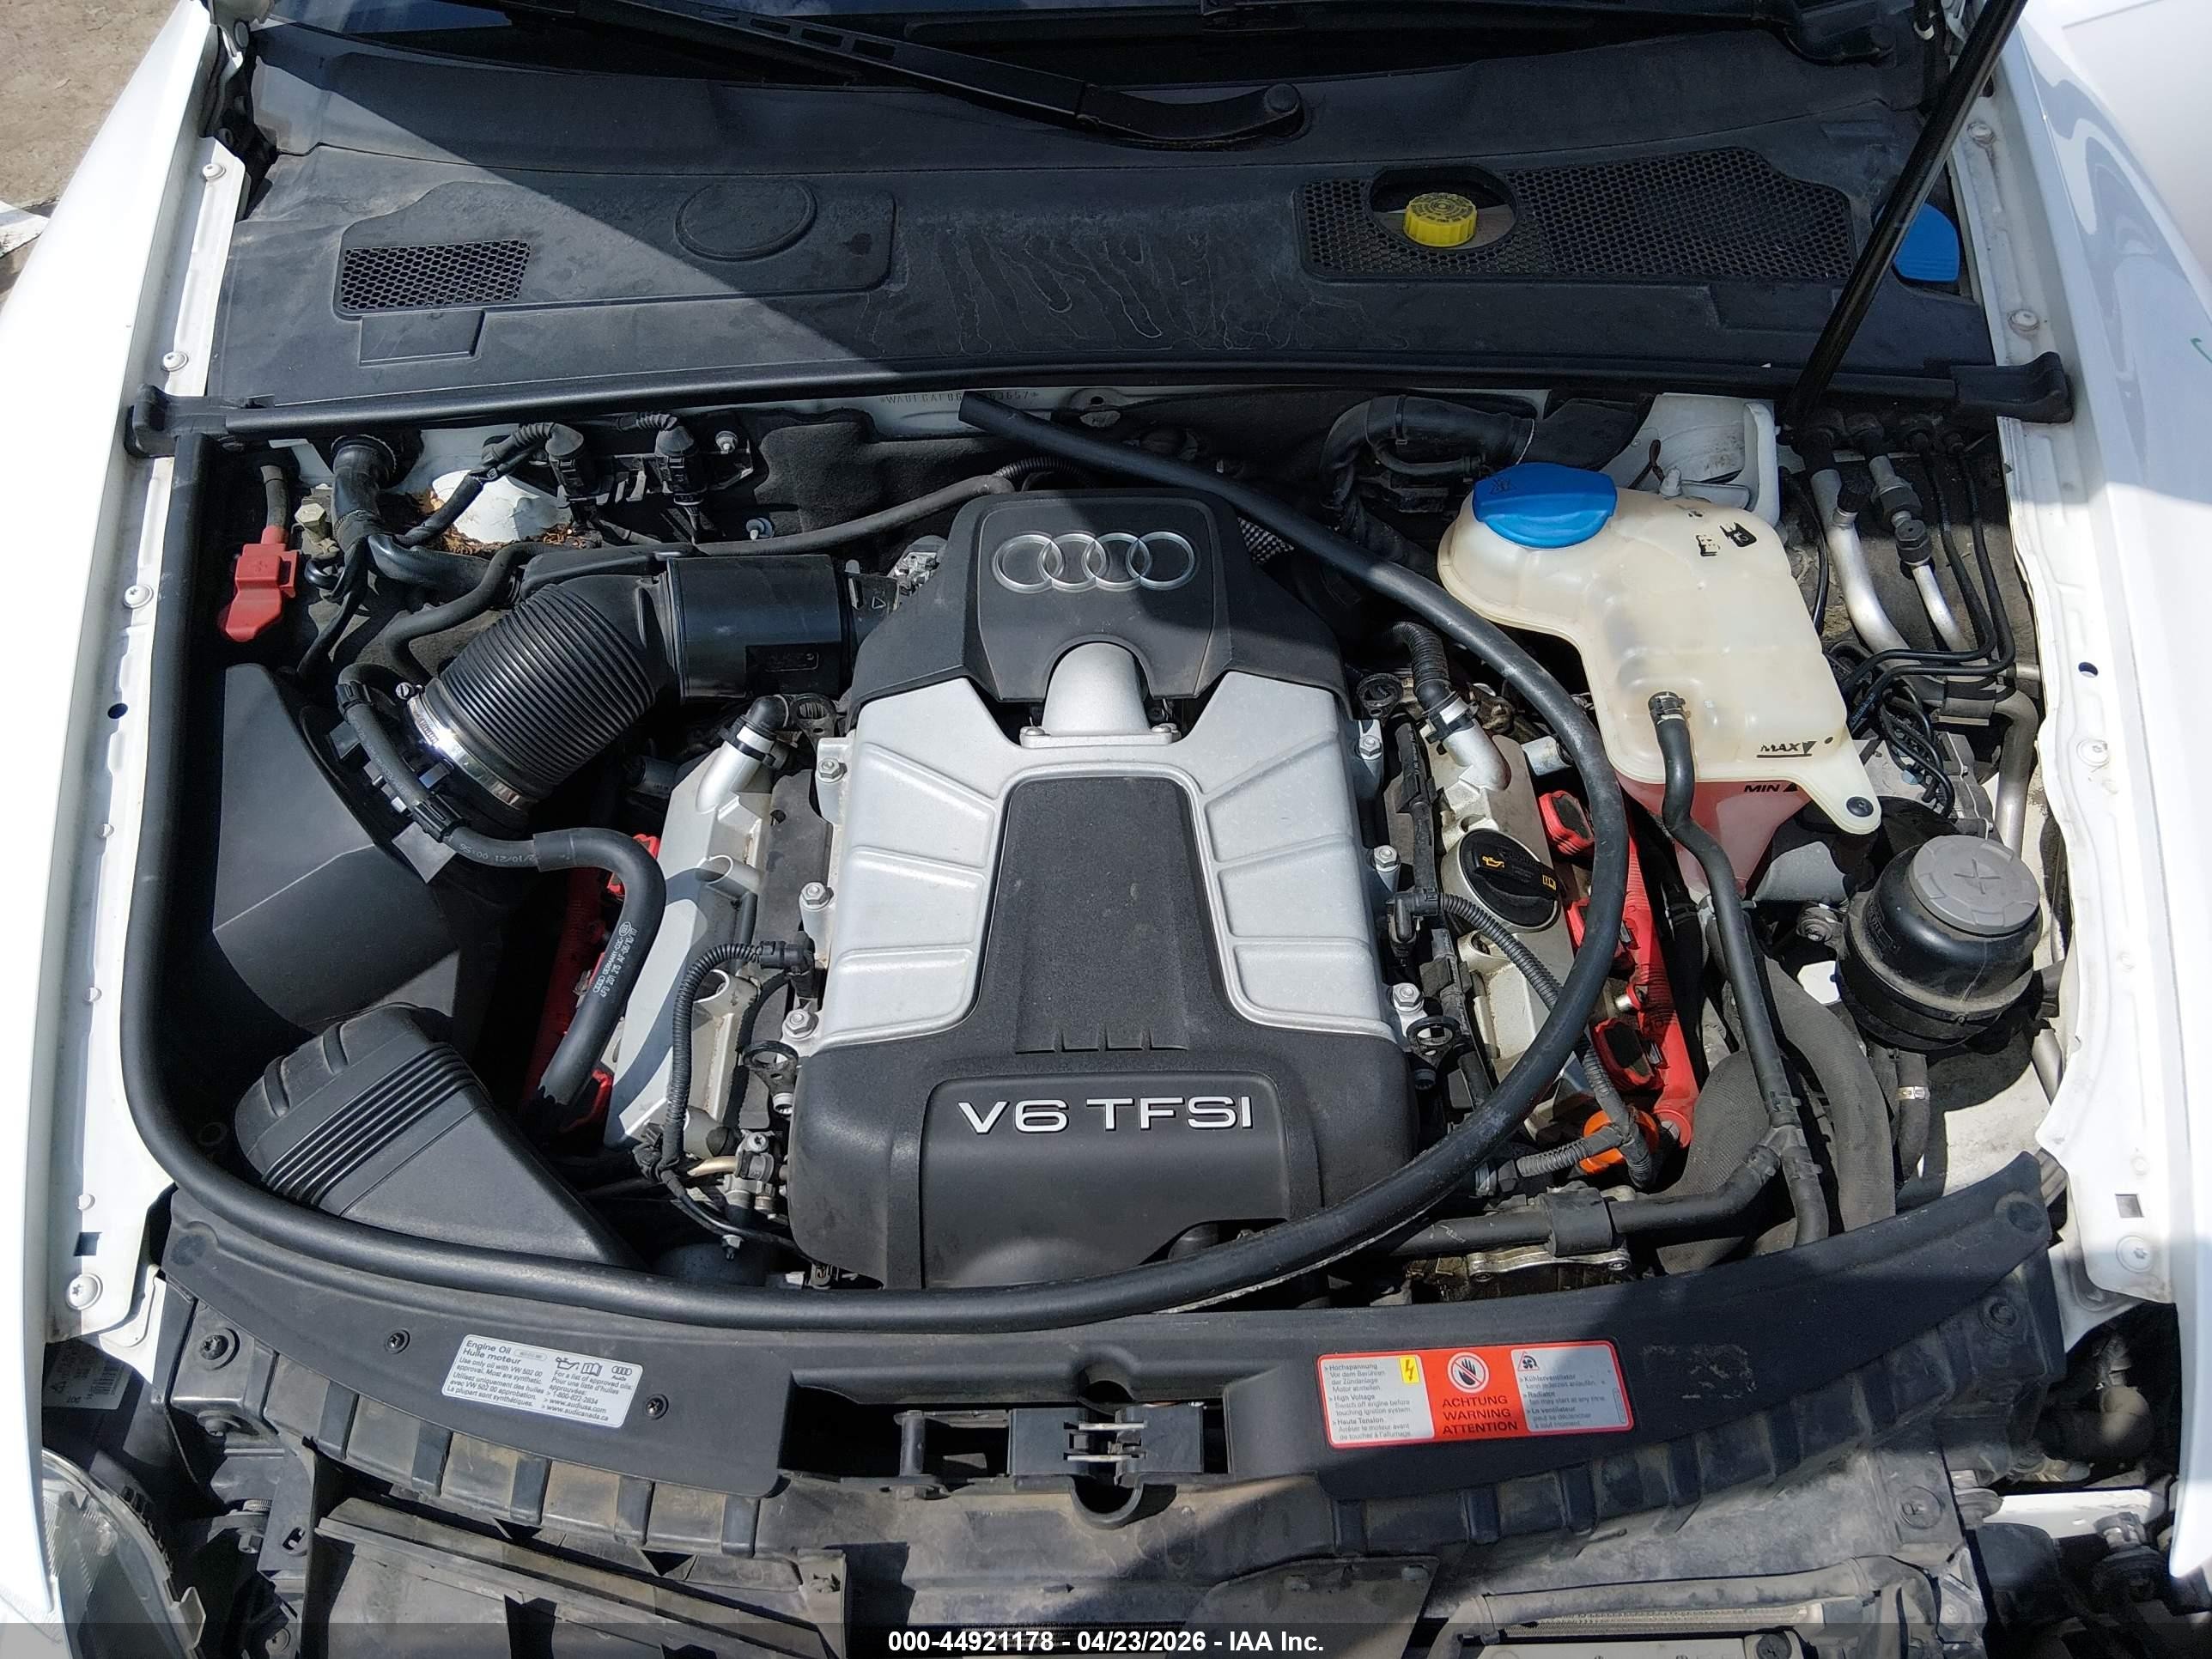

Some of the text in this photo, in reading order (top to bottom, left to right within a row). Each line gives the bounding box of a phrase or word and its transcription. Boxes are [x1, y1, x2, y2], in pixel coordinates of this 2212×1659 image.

[1760, 743, 1801, 752] MAX
[958, 1096, 1254, 1133] V6 TFSI
[466, 1340, 496, 1352] Engine
[463, 1348, 484, 1358] Huile
[488, 1353, 520, 1364] moteur
[457, 1364, 484, 1374] approval.
[514, 1375, 543, 1384] synthetic.
[453, 1372, 475, 1381] Utilisez
[476, 1377, 513, 1388] uniquement
[526, 1385, 544, 1394] huiles
[580, 1381, 593, 1389] liste
[594, 1384, 618, 1395] d'huiles
[589, 1378, 619, 1388] approved
[498, 1388, 536, 1400] approbation.
[1443, 1395, 1508, 1407] ACHTUNG
[547, 1405, 608, 1420] www.audicanada.ca
[1443, 1408, 1510, 1420] WARNING
[1443, 1422, 1517, 1434] ATTENTION
